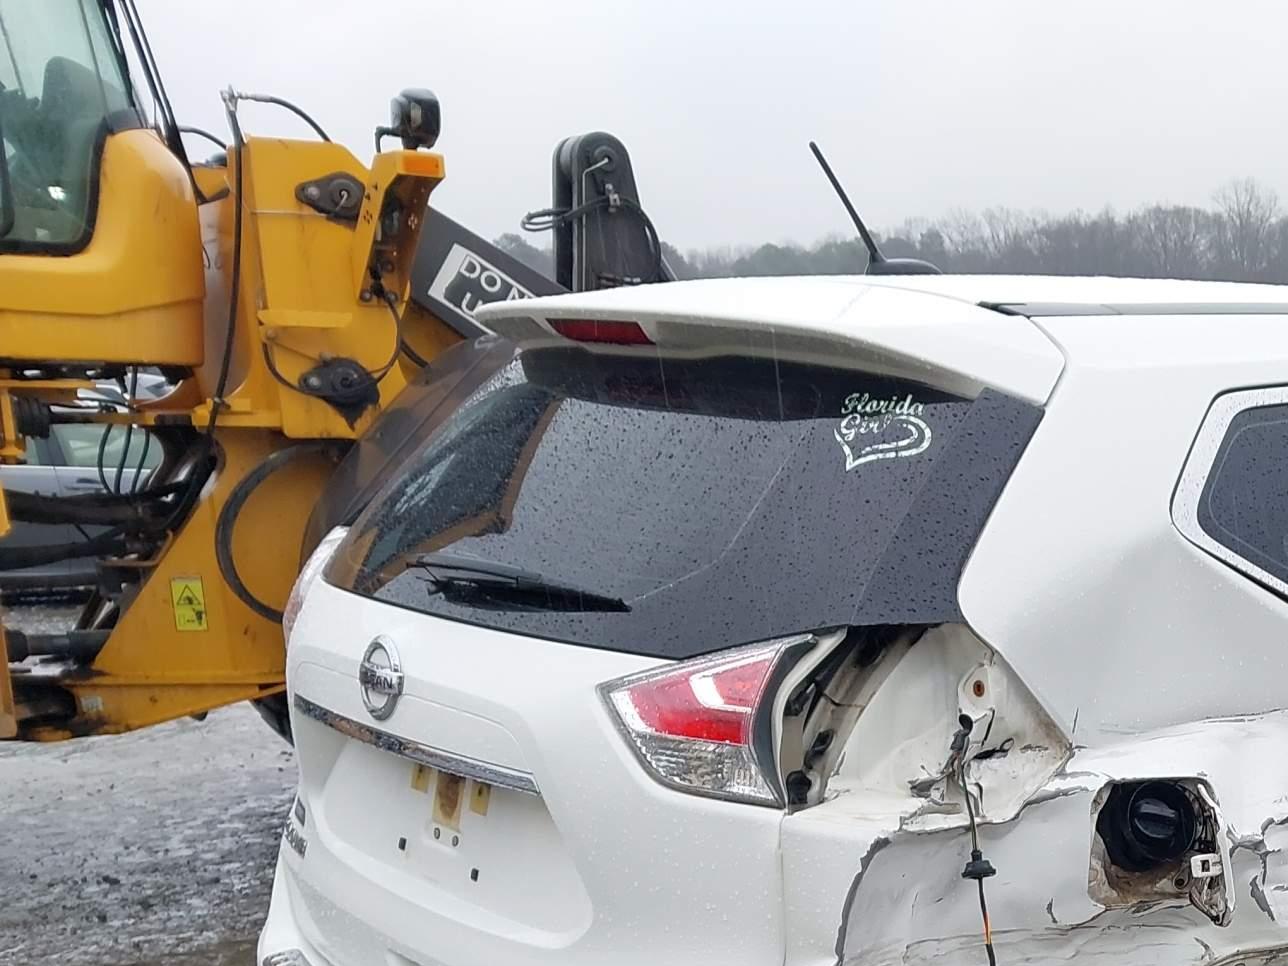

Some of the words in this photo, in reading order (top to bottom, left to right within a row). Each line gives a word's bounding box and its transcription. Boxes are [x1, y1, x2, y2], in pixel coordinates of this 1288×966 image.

[459, 254, 502, 293] DO
[840, 392, 925, 415] Florida
[840, 413, 893, 441] Girl
